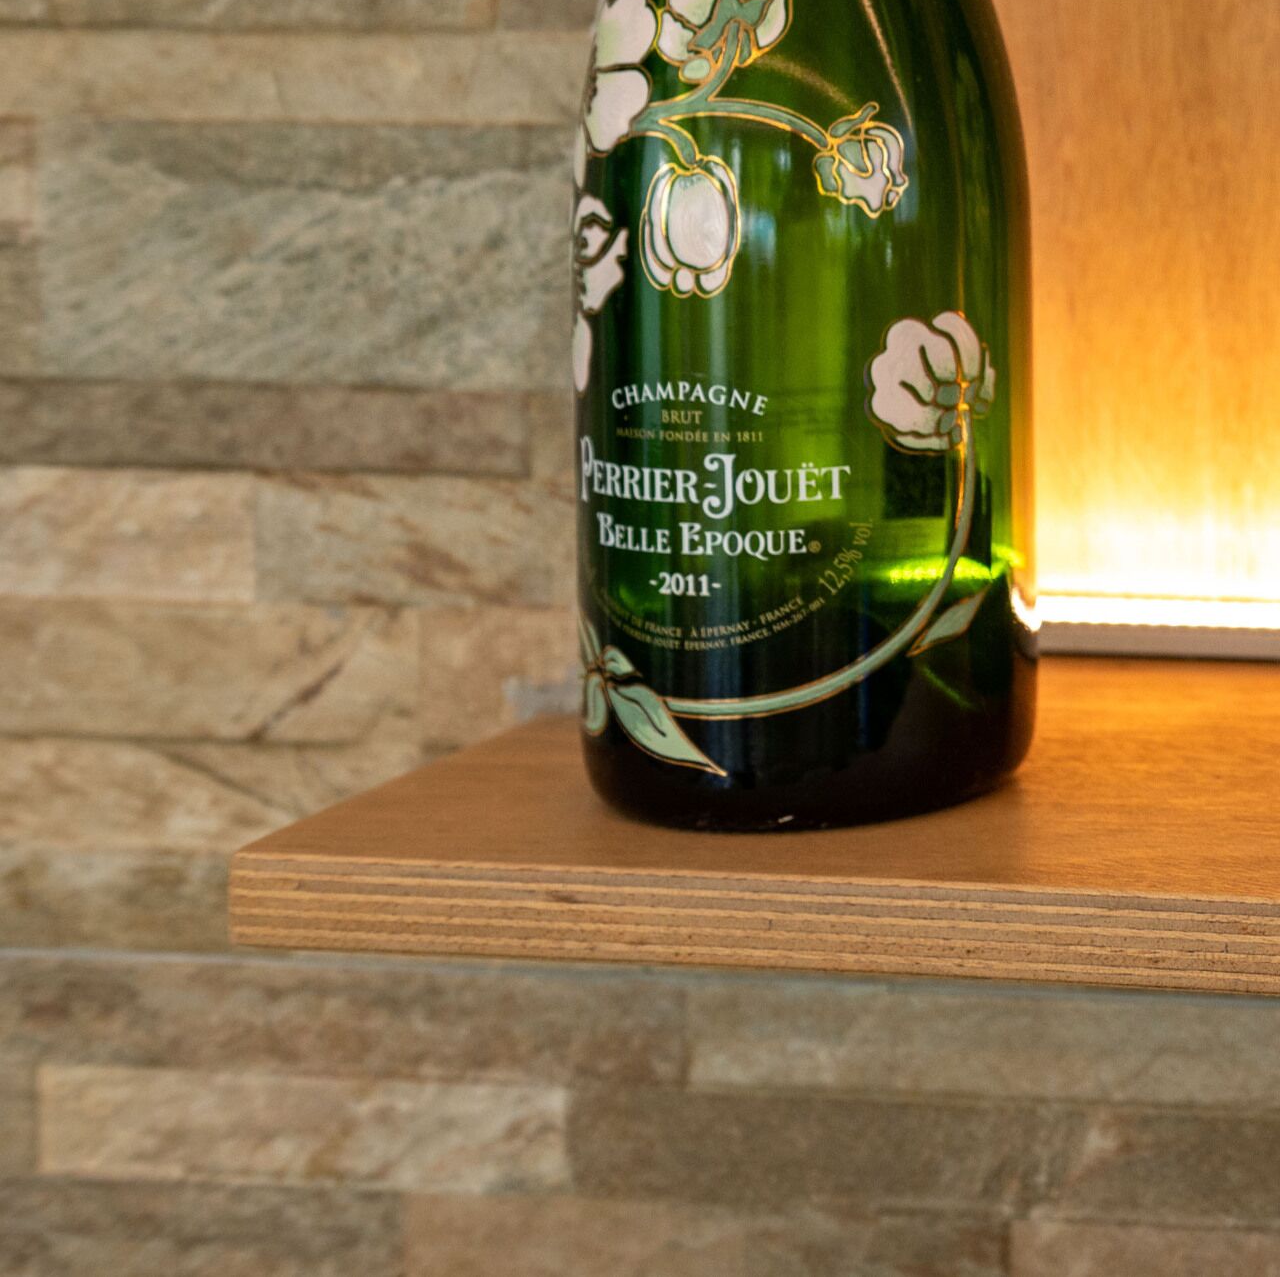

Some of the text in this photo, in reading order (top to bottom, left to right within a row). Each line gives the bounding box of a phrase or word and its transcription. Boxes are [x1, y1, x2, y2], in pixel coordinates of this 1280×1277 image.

[611, 381, 769, 416] CHAMPAGNE
[661, 409, 703, 424] BRUT
[713, 432, 731, 442] EN
[736, 431, 763, 442] 1811
[580, 436, 851, 520] PERRIER-JOUËT
[597, 511, 671, 555] BELLE
[819, 547, 863, 595] 12,5%
[759, 595, 804, 625] FRANCE
